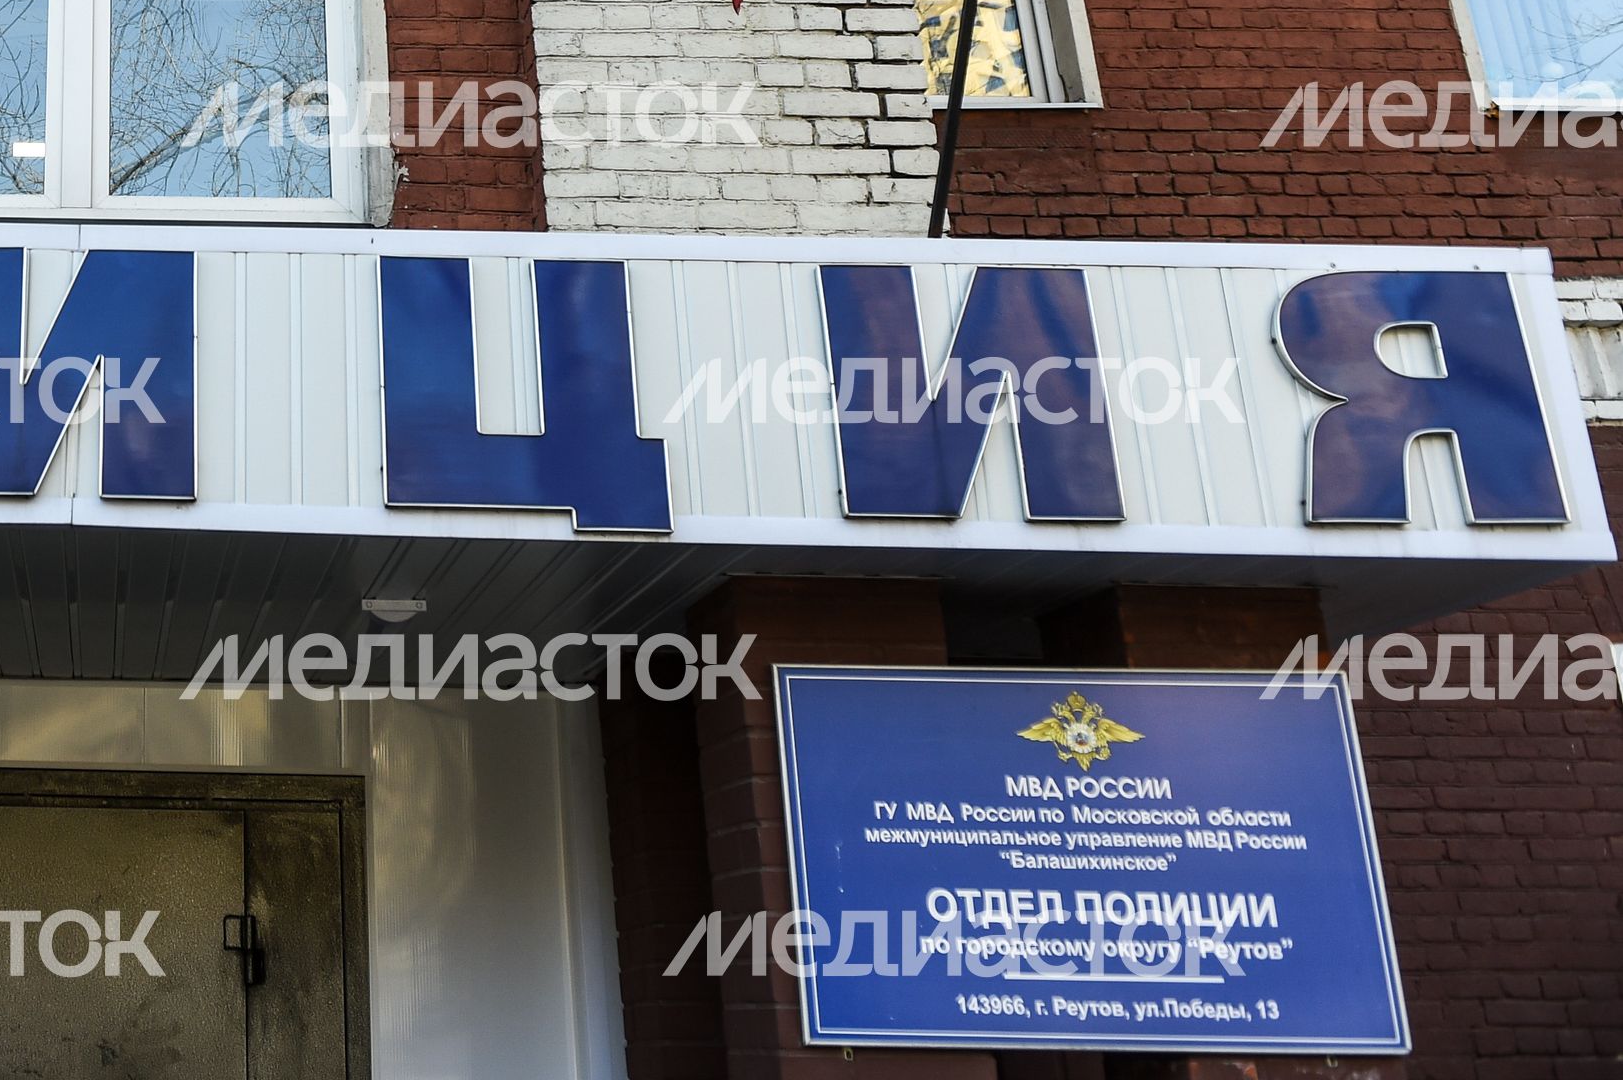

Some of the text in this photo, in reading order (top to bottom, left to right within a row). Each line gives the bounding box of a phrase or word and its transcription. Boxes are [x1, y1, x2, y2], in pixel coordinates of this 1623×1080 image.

[1004, 775, 1172, 800] МВД РОССИИ
[873, 801, 1292, 827] ГУ МВД России по Московской области
[864, 827, 1307, 852] межмуниципальное управление МВД России
[926, 887, 1278, 933] ОТДЕЛ ПОЛИЦИИ
[919, 936, 950, 954] по
[955, 936, 1095, 961] городскому
[1101, 939, 1182, 963] округу
[955, 993, 1031, 1018] 143966,
[1034, 999, 1048, 1016] г.
[1051, 995, 1130, 1021] Реутов,
[1255, 999, 1280, 1020] 13
